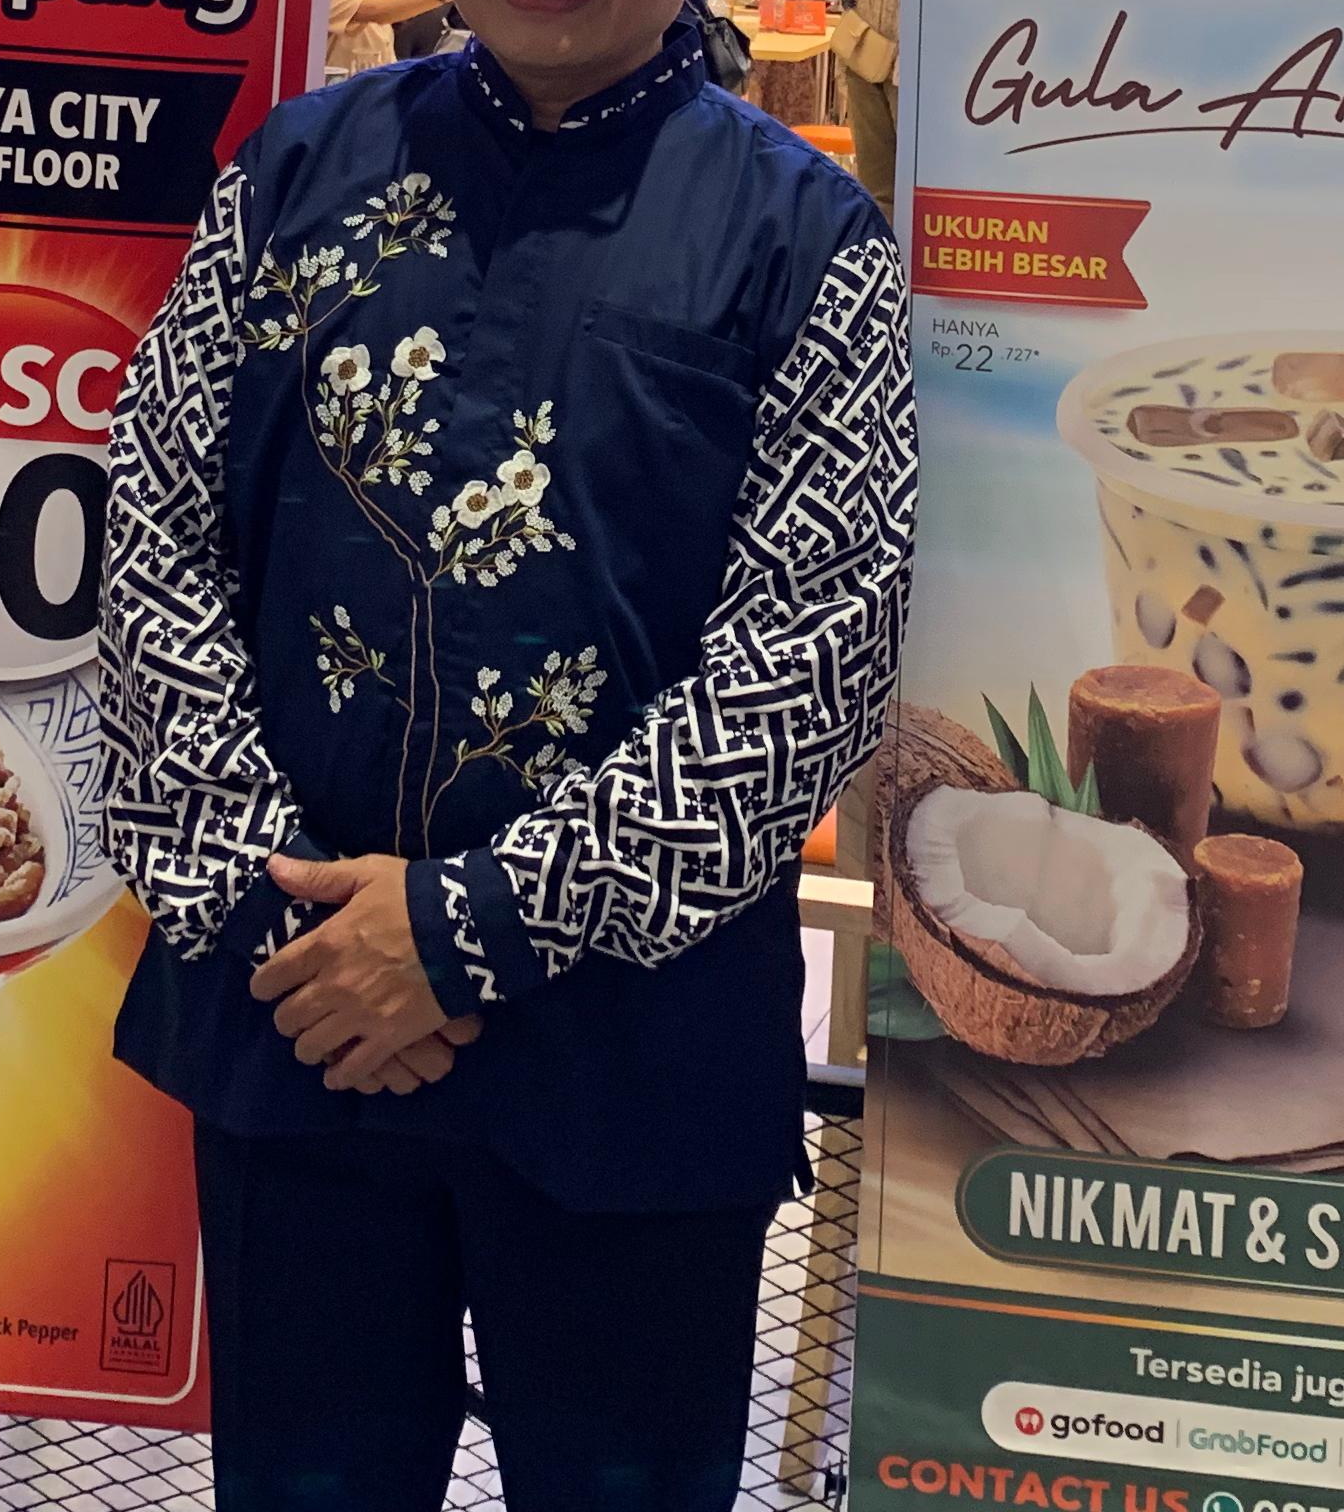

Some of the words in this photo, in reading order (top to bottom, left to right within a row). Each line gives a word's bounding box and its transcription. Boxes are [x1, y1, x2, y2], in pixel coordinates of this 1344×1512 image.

[964, 10, 1184, 128] Gula
[50, 91, 161, 146] CITY
[923, 213, 1049, 245] UKURAN
[922, 246, 1004, 275] LEBIH
[1013, 253, 1108, 281] BESAR
[932, 318, 1000, 339] HANYA
[1008, 1171, 1237, 1259] NIKMAT
[1245, 1196, 1287, 1266] &
[17, 1318, 80, 1345] Pepper
[111, 1336, 161, 1352] HALAL
[1129, 1346, 1284, 1396] Tersedia
[1050, 1405, 1166, 1446] gofood
[1187, 1426, 1329, 1465] GrabFood
[877, 1454, 1114, 1512] CONTACT
